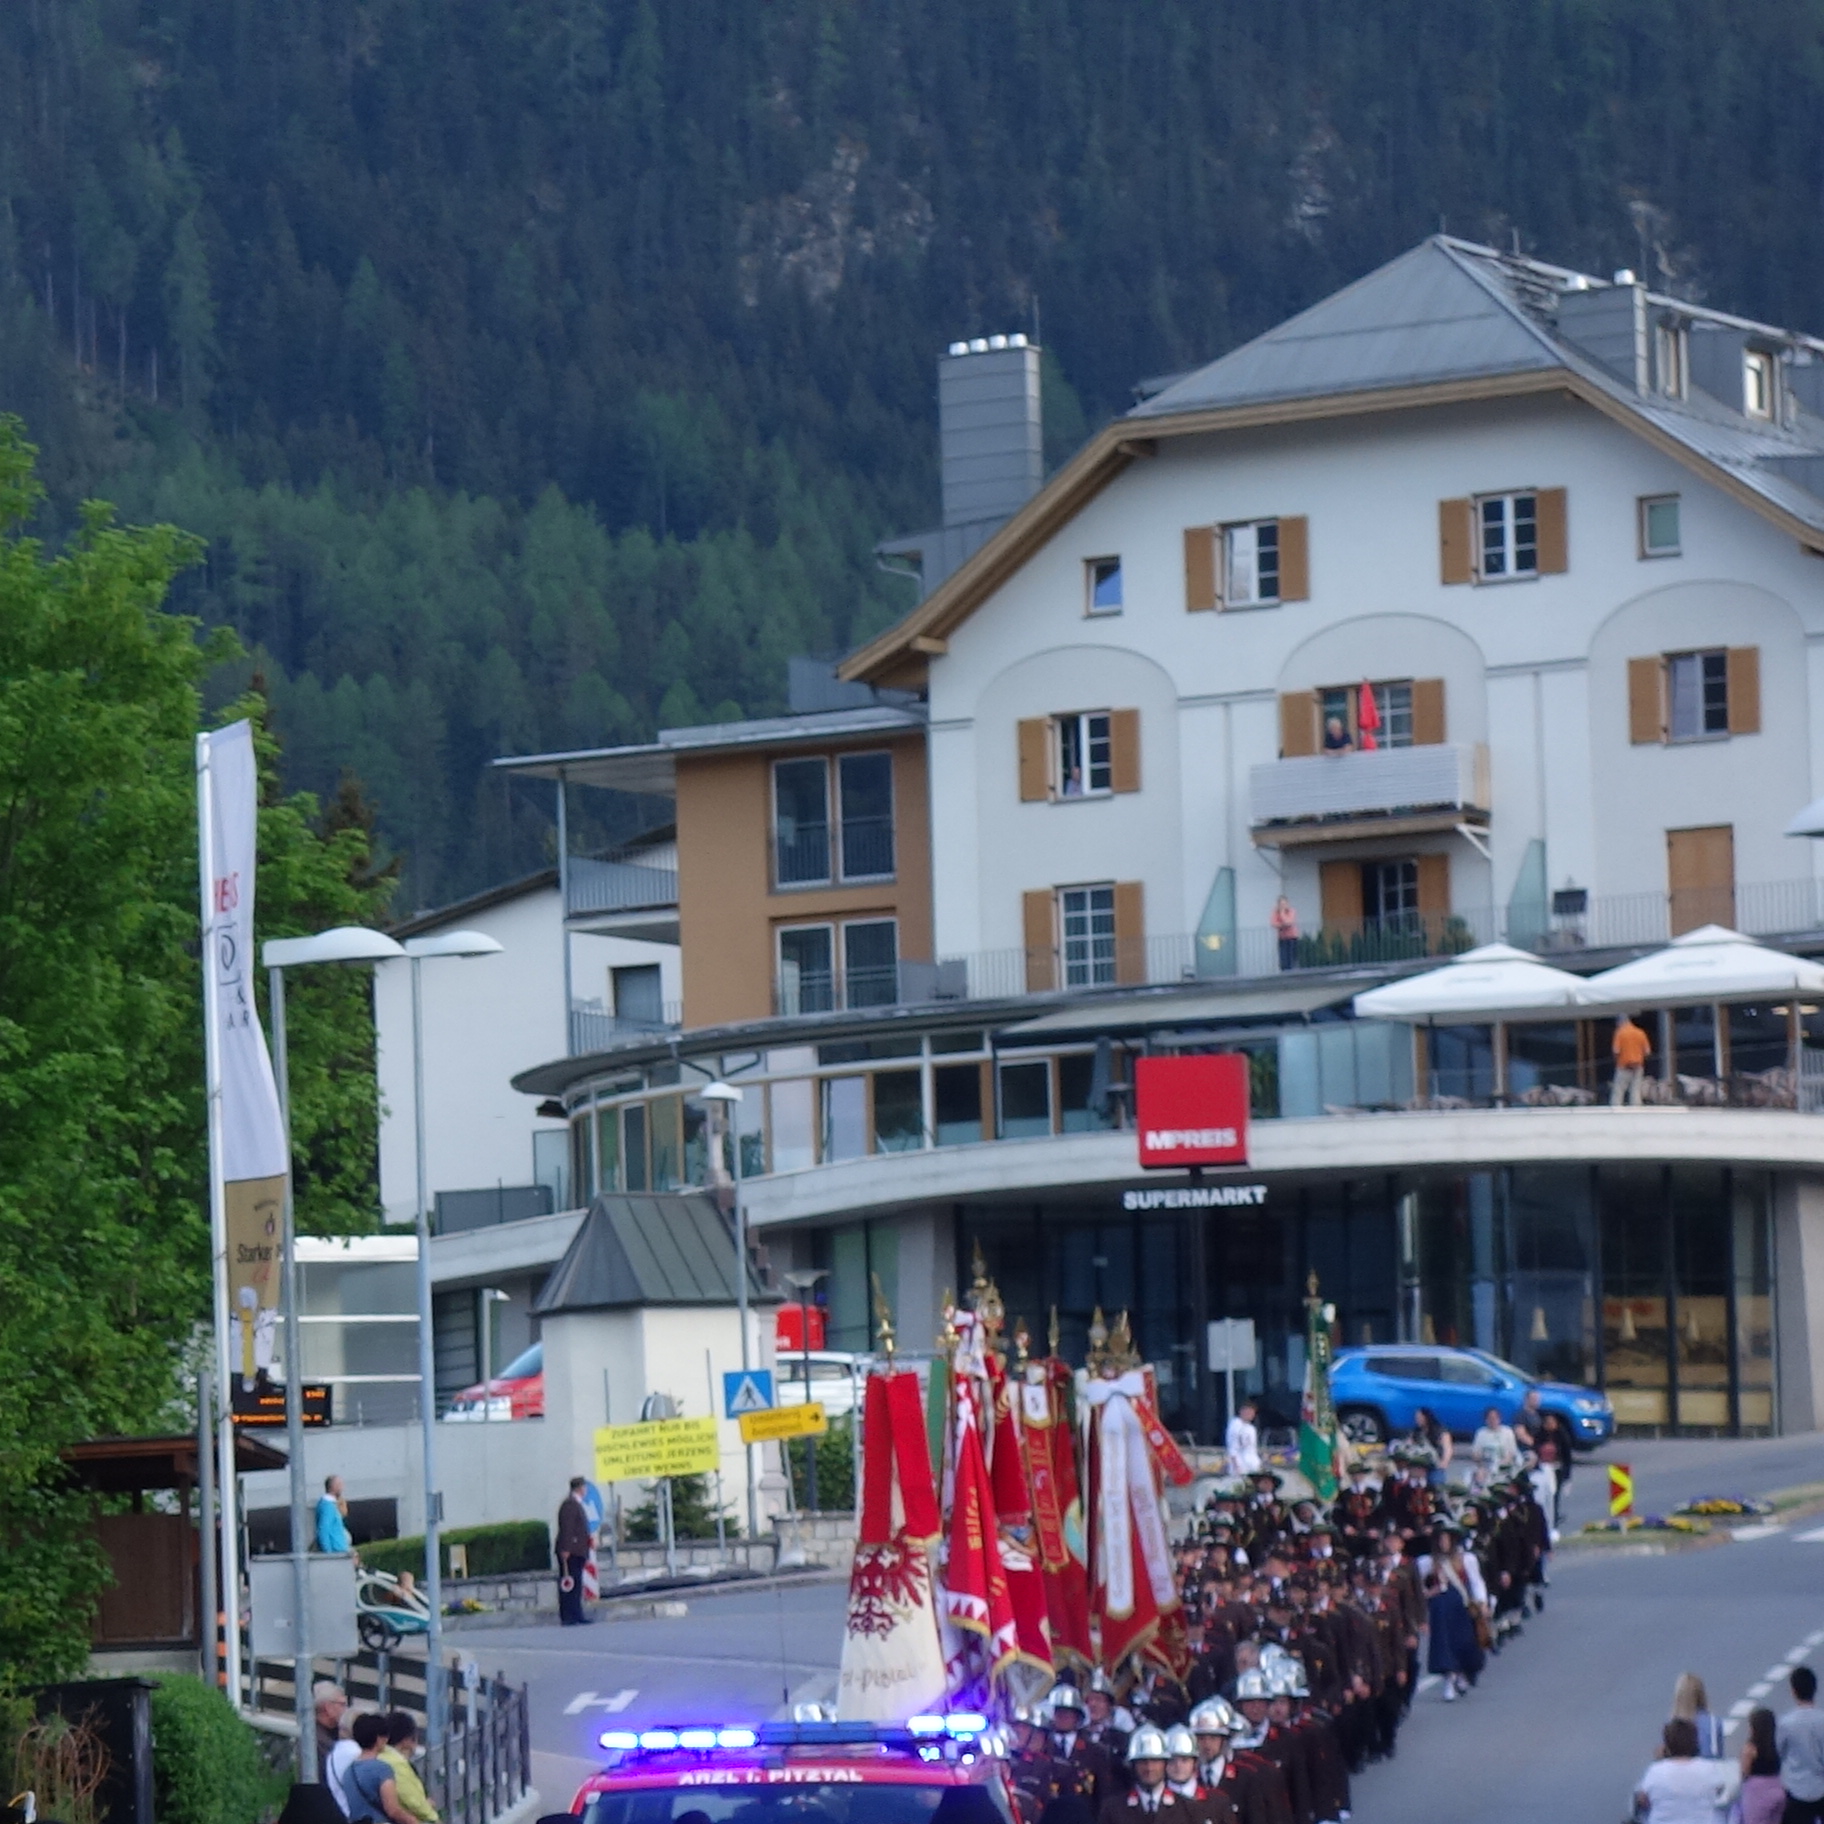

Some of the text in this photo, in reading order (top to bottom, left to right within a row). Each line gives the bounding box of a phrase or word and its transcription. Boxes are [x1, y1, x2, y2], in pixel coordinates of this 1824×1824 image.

[1146, 1128, 1237, 1151] MPREIS
[1123, 1185, 1268, 1211] SUPERMARKT
[612, 1420, 701, 1438] ZUFAHRT NUR BIS
[603, 1451, 663, 1466] UMLEITUNG
[679, 1768, 740, 1786] ARZL
[768, 1766, 863, 1783] PITZTAL
